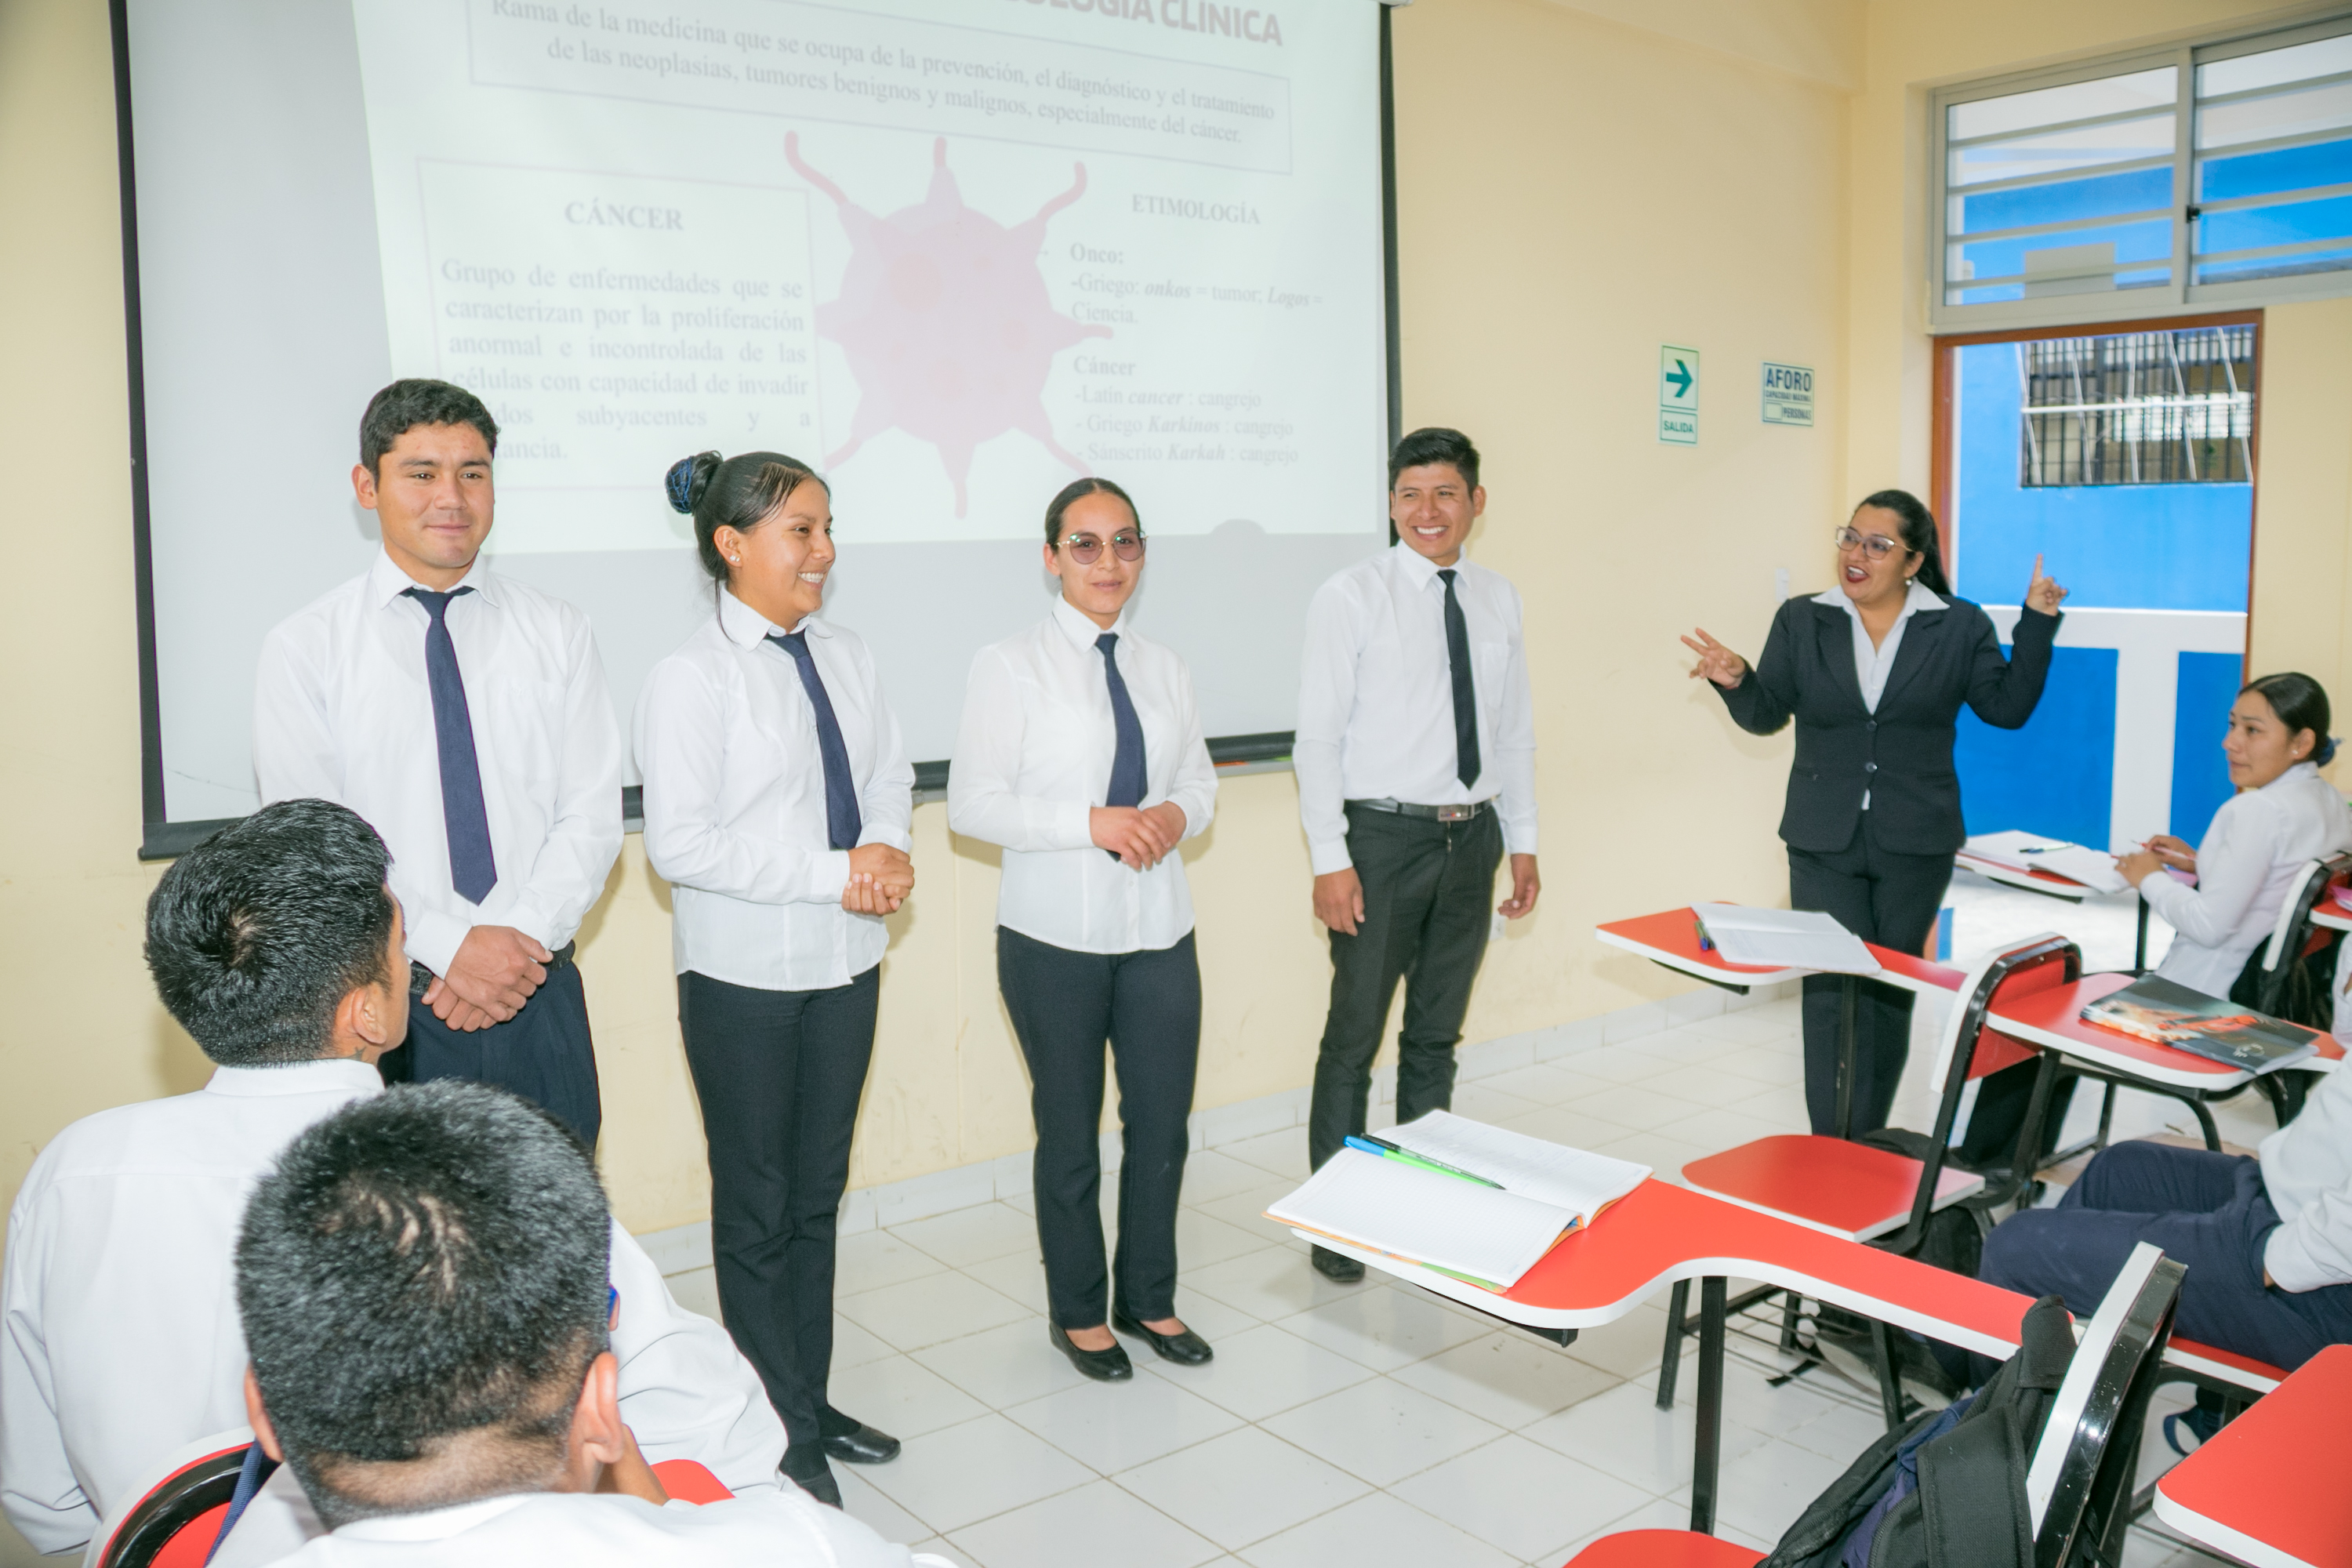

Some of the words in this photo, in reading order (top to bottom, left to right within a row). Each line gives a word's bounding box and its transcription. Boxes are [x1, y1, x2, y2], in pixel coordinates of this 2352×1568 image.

[492, 0, 559, 24] Rama
[565, 3, 592, 28] de
[599, 7, 619, 33] la
[626, 15, 727, 45] medicina
[734, 29, 771, 53] que
[777, 37, 799, 54] se
[805, 39, 864, 66] ocupa
[870, 44, 893, 67] de
[899, 47, 916, 70] la
[922, 56, 1029, 88] prevención,
[1035, 68, 1051, 88] el
[1055, 71, 1151, 102] diagnóstico
[1155, 89, 1167, 107] y
[1172, 88, 1186, 107] el
[1191, 92, 1275, 119] tratamiento
[546, 36, 575, 60] de
[581, 39, 612, 65] las
[619, 51, 739, 84] neoplasias,
[745, 64, 828, 90] tumores
[833, 71, 921, 103] benignos
[927, 88, 938, 109] y
[945, 89, 1033, 118] malignos,
[1037, 103, 1157, 131] especialmente
[1161, 114, 1185, 135] del
[1190, 120, 1242, 143] cáncer.
[564, 197, 684, 230] CÁNCER
[1132, 194, 1261, 224] ETIMOLOGÍA
[1069, 241, 1123, 264] Onco:
[441, 258, 516, 290] Grupo
[528, 263, 556, 287] de
[568, 267, 720, 295] enfermedades
[732, 279, 769, 302] que
[781, 282, 803, 299] se
[1144, 279, 1191, 299] onkos
[1211, 285, 1262, 306] tumor;
[1266, 286, 1310, 310] Logos
[445, 299, 583, 324] caracterizan
[593, 307, 630, 330] por
[641, 304, 661, 326] la
[671, 306, 804, 333] proliferación
[1072, 301, 1138, 324] Ciencia.
[449, 334, 542, 357] anormal
[559, 341, 572, 358] e
[590, 336, 724, 361] incontrolada
[739, 341, 764, 363] de
[779, 342, 807, 364] las
[1073, 355, 1136, 376] Cáncer
[452, 367, 533, 390] células
[540, 374, 581, 392] con
[589, 372, 697, 397] capacidad
[706, 372, 730, 394] de
[738, 373, 808, 395] invadir
[1766, 368, 1812, 392] AFORO
[1127, 390, 1184, 406] cancer
[1198, 390, 1261, 411] cangrejo
[1784, 407, 1812, 420] PERSONAS
[576, 404, 707, 431] subyacentes
[747, 412, 760, 432] y
[799, 412, 811, 427] a
[1087, 414, 1143, 437] Griego
[1147, 415, 1221, 434] Karkinos
[1234, 419, 1294, 440] cangrejo
[1664, 420, 1694, 434] SALIDA
[1088, 442, 1163, 462] Sánscrito
[1166, 443, 1225, 461] Karkah
[1239, 446, 1298, 466] cangrejo
